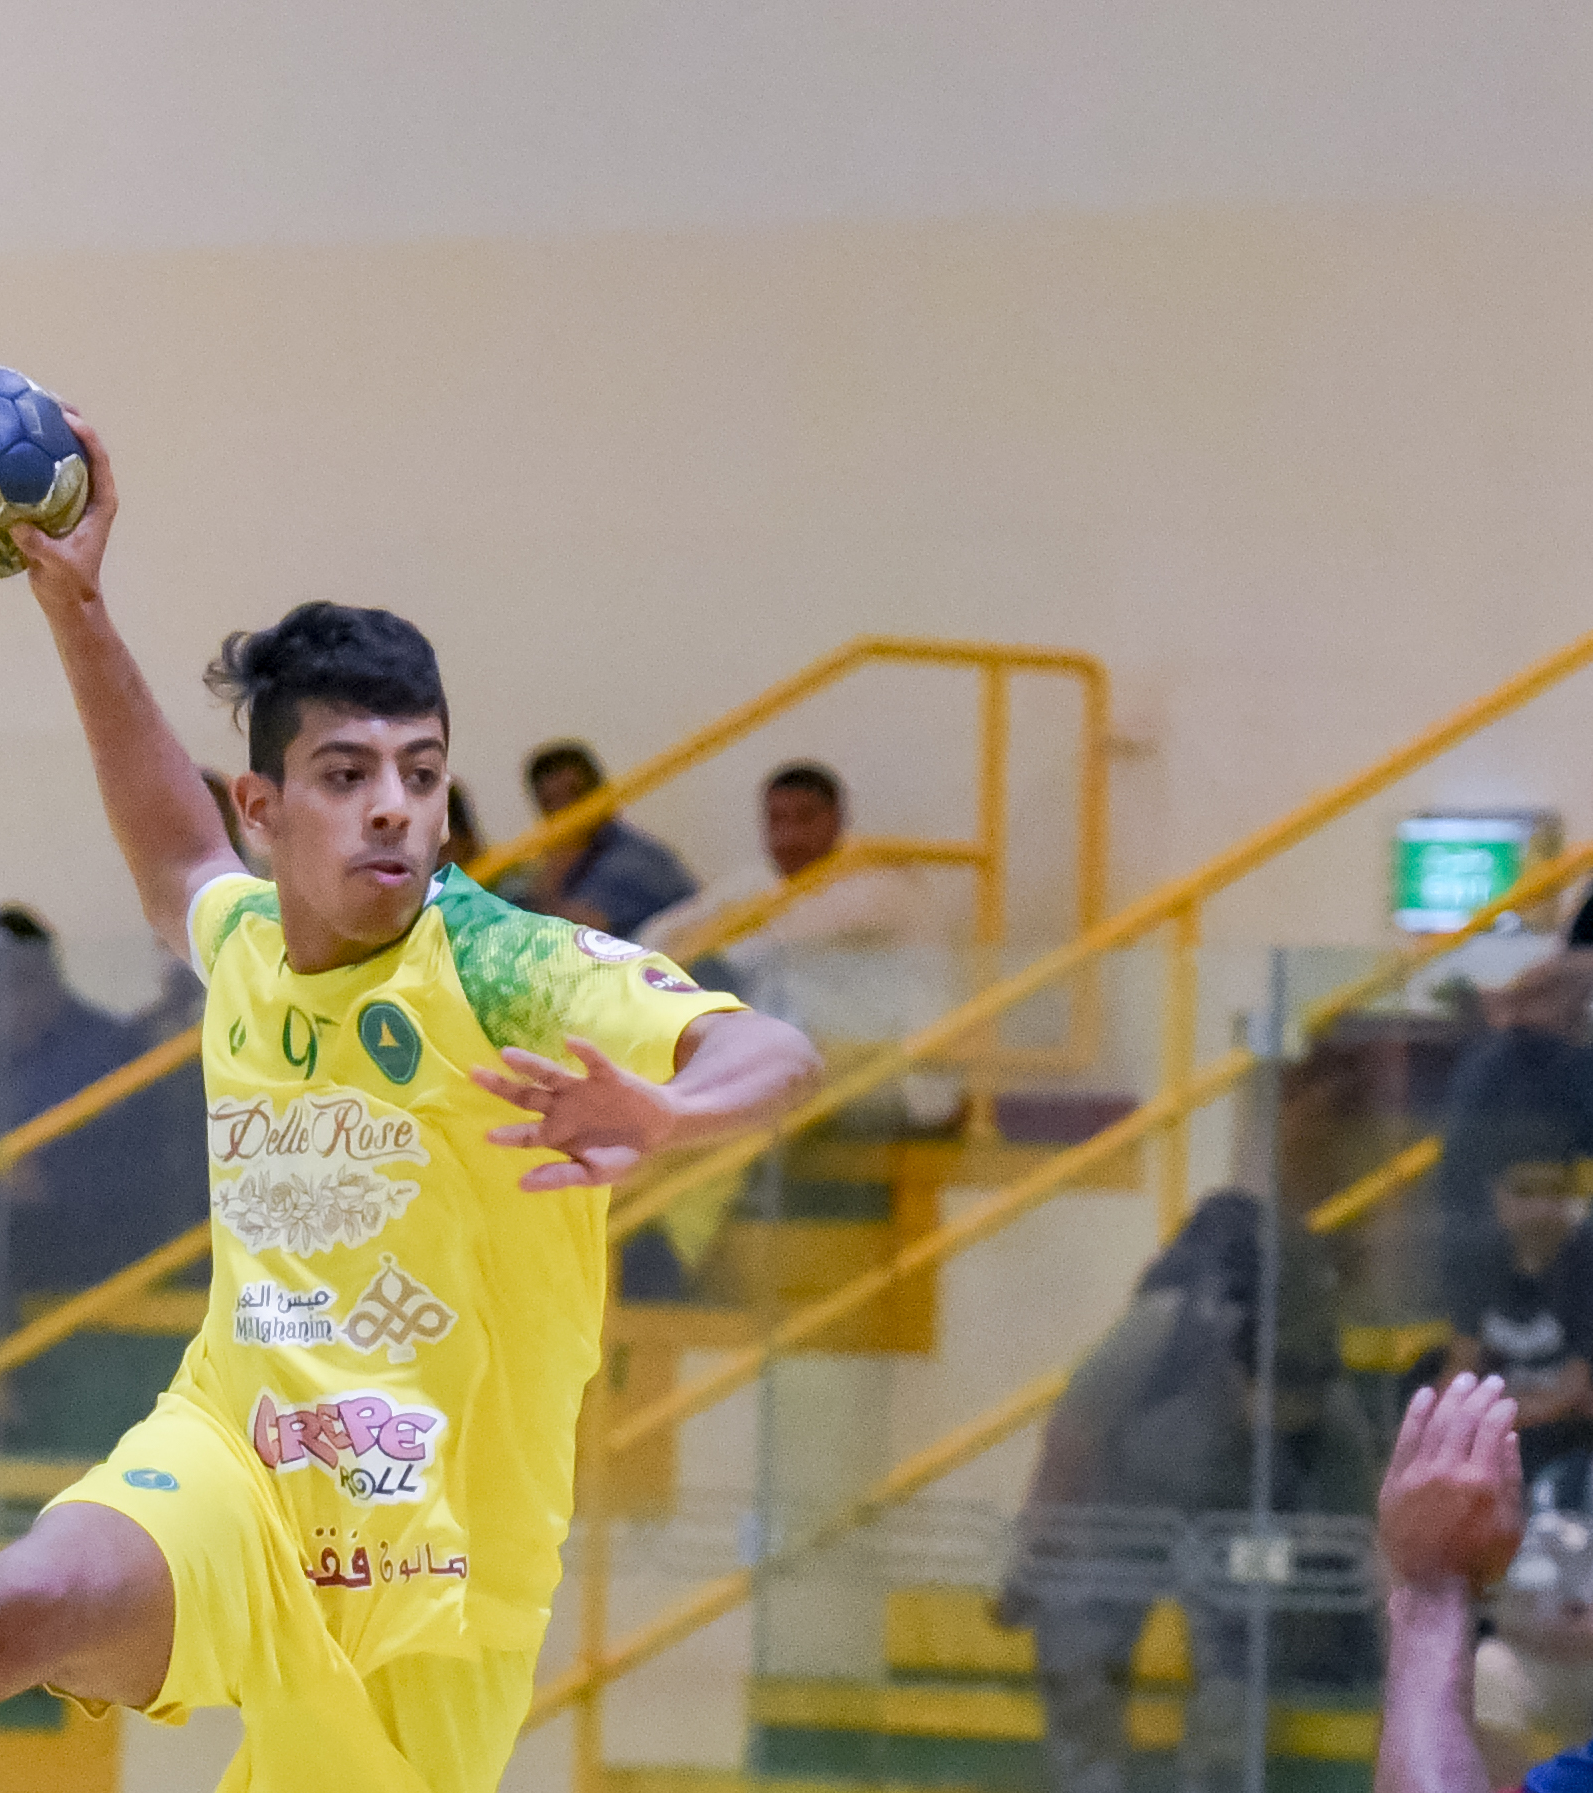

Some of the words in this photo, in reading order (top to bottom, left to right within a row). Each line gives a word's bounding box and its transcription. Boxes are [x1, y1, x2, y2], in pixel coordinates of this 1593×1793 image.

[209, 1100, 309, 1162] Delle
[310, 1099, 425, 1160] Rose
[253, 1394, 438, 1470] CREPE
[340, 1463, 418, 1500] ROLL
